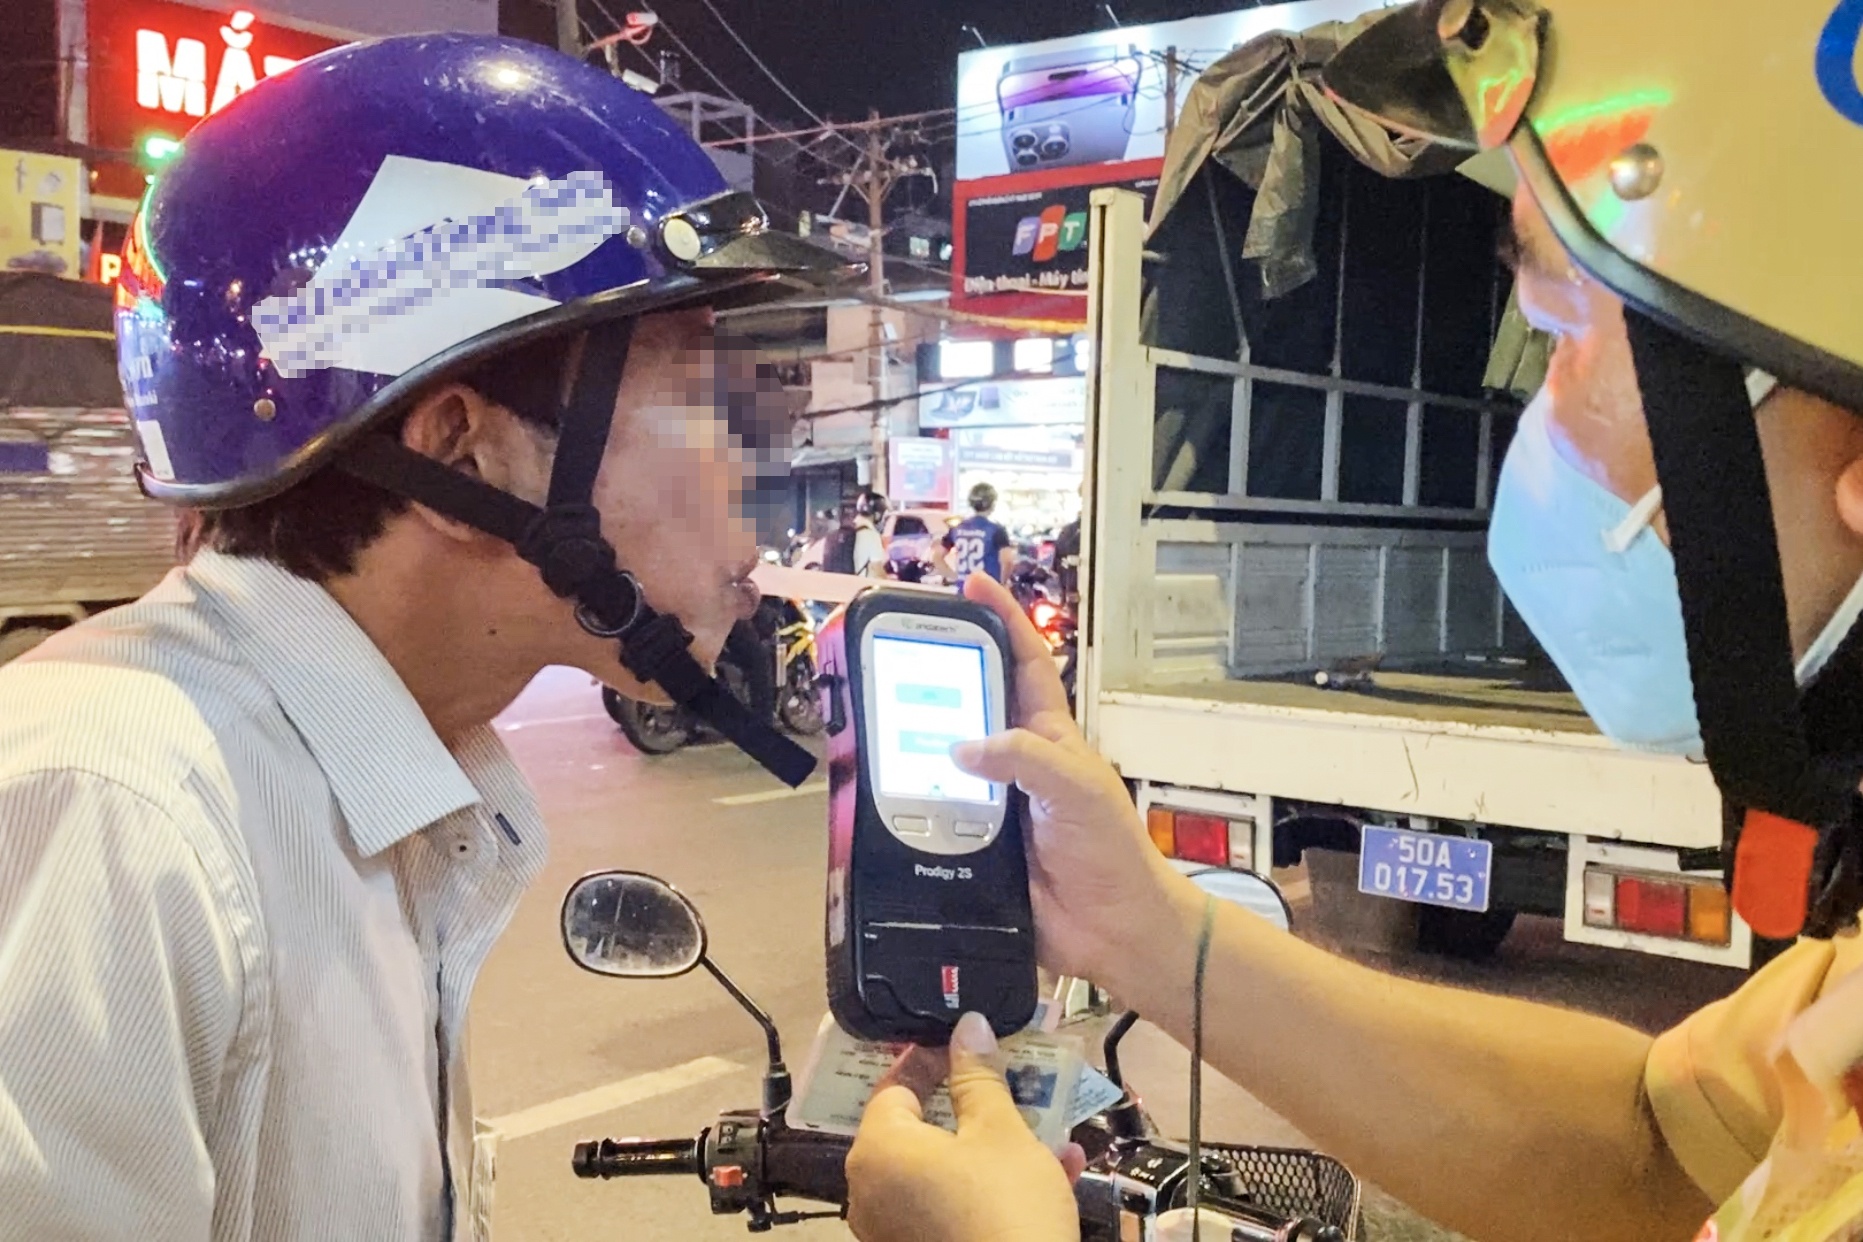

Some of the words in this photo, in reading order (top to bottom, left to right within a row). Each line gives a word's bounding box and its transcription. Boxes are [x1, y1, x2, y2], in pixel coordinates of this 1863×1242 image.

[956, 537, 985, 573] 22
[1398, 836, 1452, 869] 50A
[914, 863, 956, 881] Prodigy
[957, 866, 973, 880] 2S
[1374, 861, 1474, 904] 017.53
